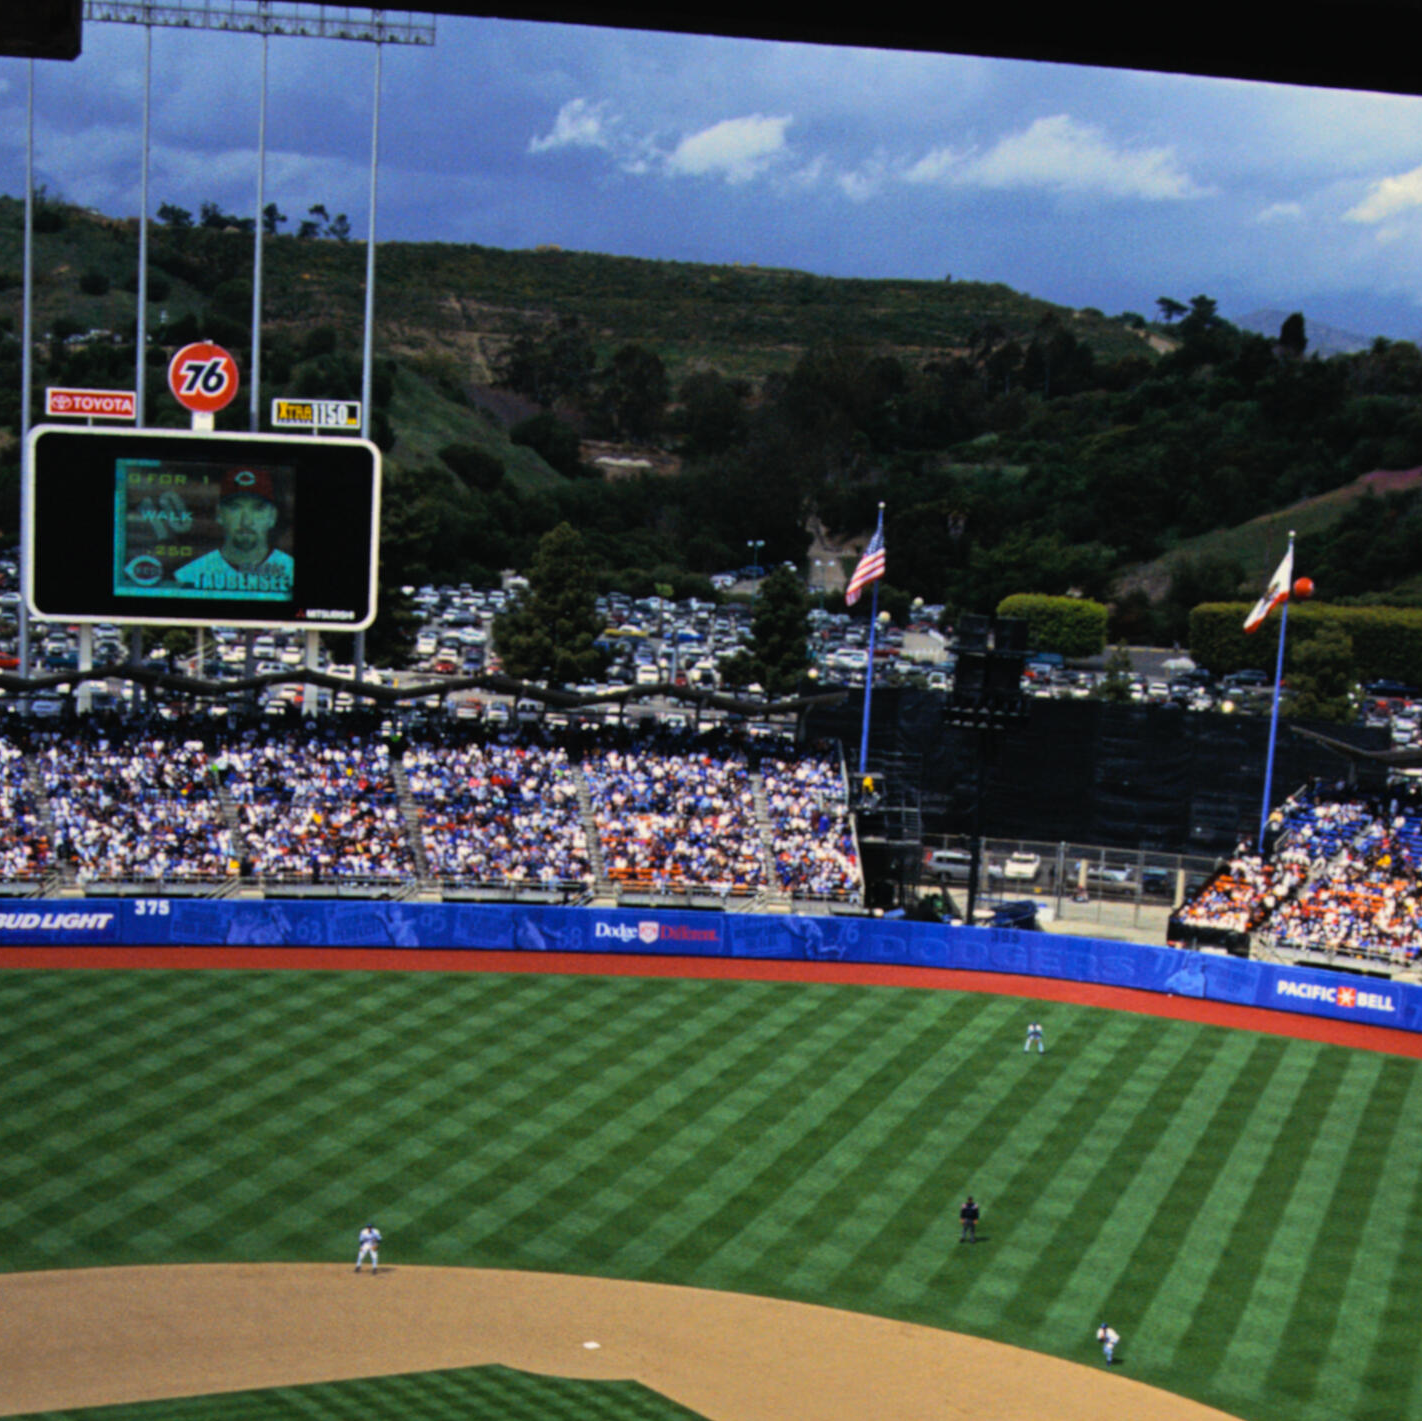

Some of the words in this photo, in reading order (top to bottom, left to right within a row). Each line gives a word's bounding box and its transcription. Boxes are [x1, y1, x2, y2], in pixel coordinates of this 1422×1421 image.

[180, 358, 226, 396] 76
[72, 396, 132, 412] TOYOTA
[313, 404, 348, 425] 1150
[148, 473, 187, 485] FOR
[141, 510, 193, 521] WALK
[135, 900, 169, 915] 375
[40, 913, 113, 929] LIGHT
[595, 922, 638, 943] Dodge
[870, 934, 1135, 979] DODGERS
[1277, 980, 1335, 1003] PACIFIC
[1356, 992, 1395, 1011] BELL
